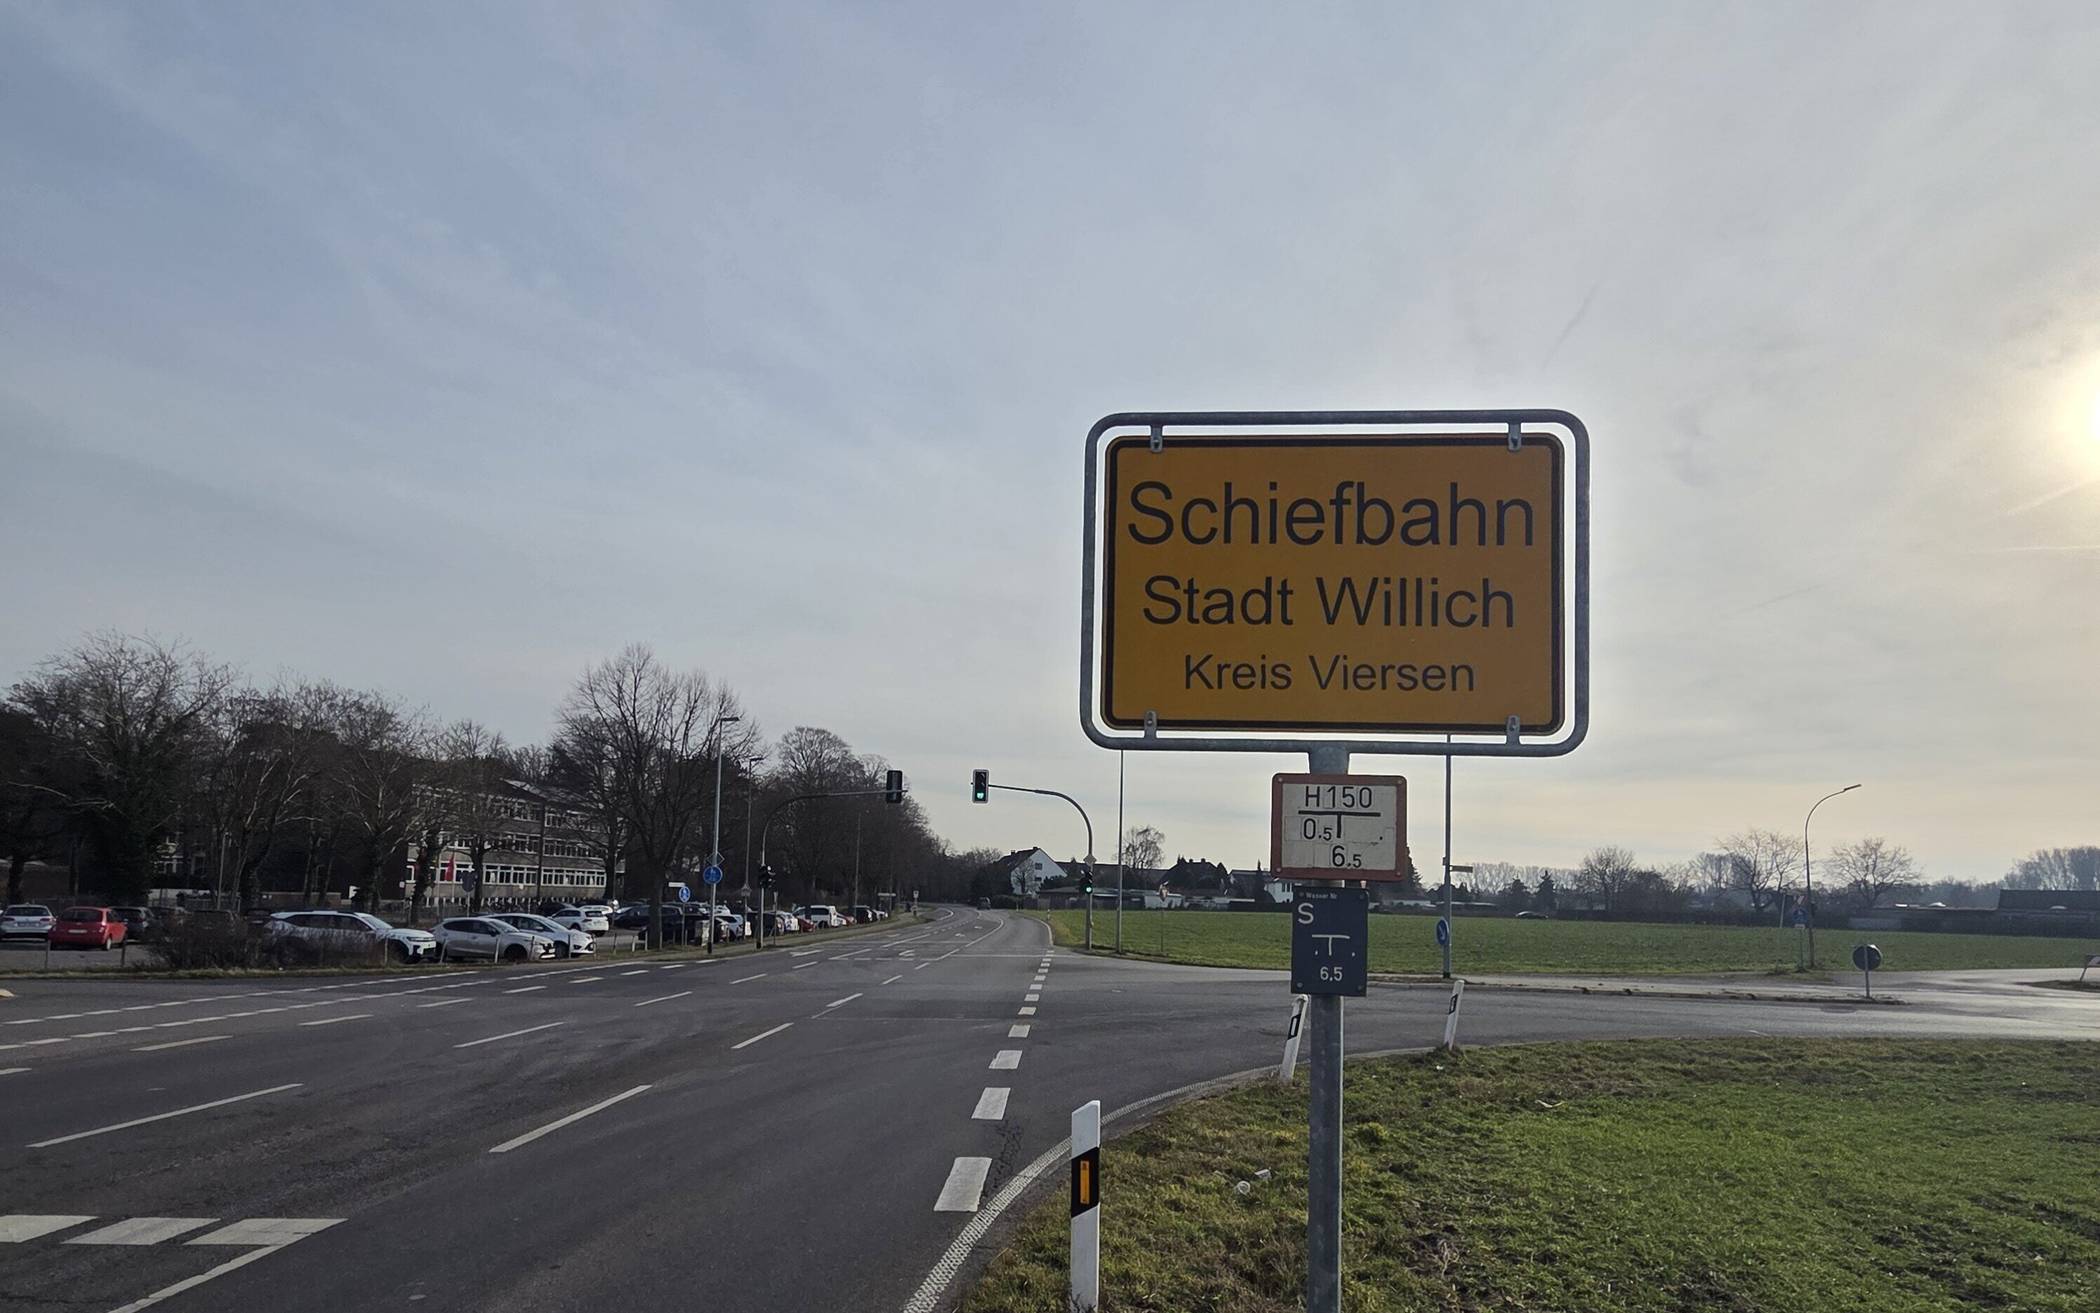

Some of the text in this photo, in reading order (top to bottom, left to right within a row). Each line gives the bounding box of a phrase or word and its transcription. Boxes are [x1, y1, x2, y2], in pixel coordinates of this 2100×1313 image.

[1128, 481, 1533, 547] Schiefbahn
[1143, 575, 1515, 628] Stadt Willich
[1185, 654, 1475, 692] Kreis Viersen
[1332, 845, 1362, 868] 6.5
[1297, 902, 1315, 924] S
[1320, 966, 1343, 982] 6.5
